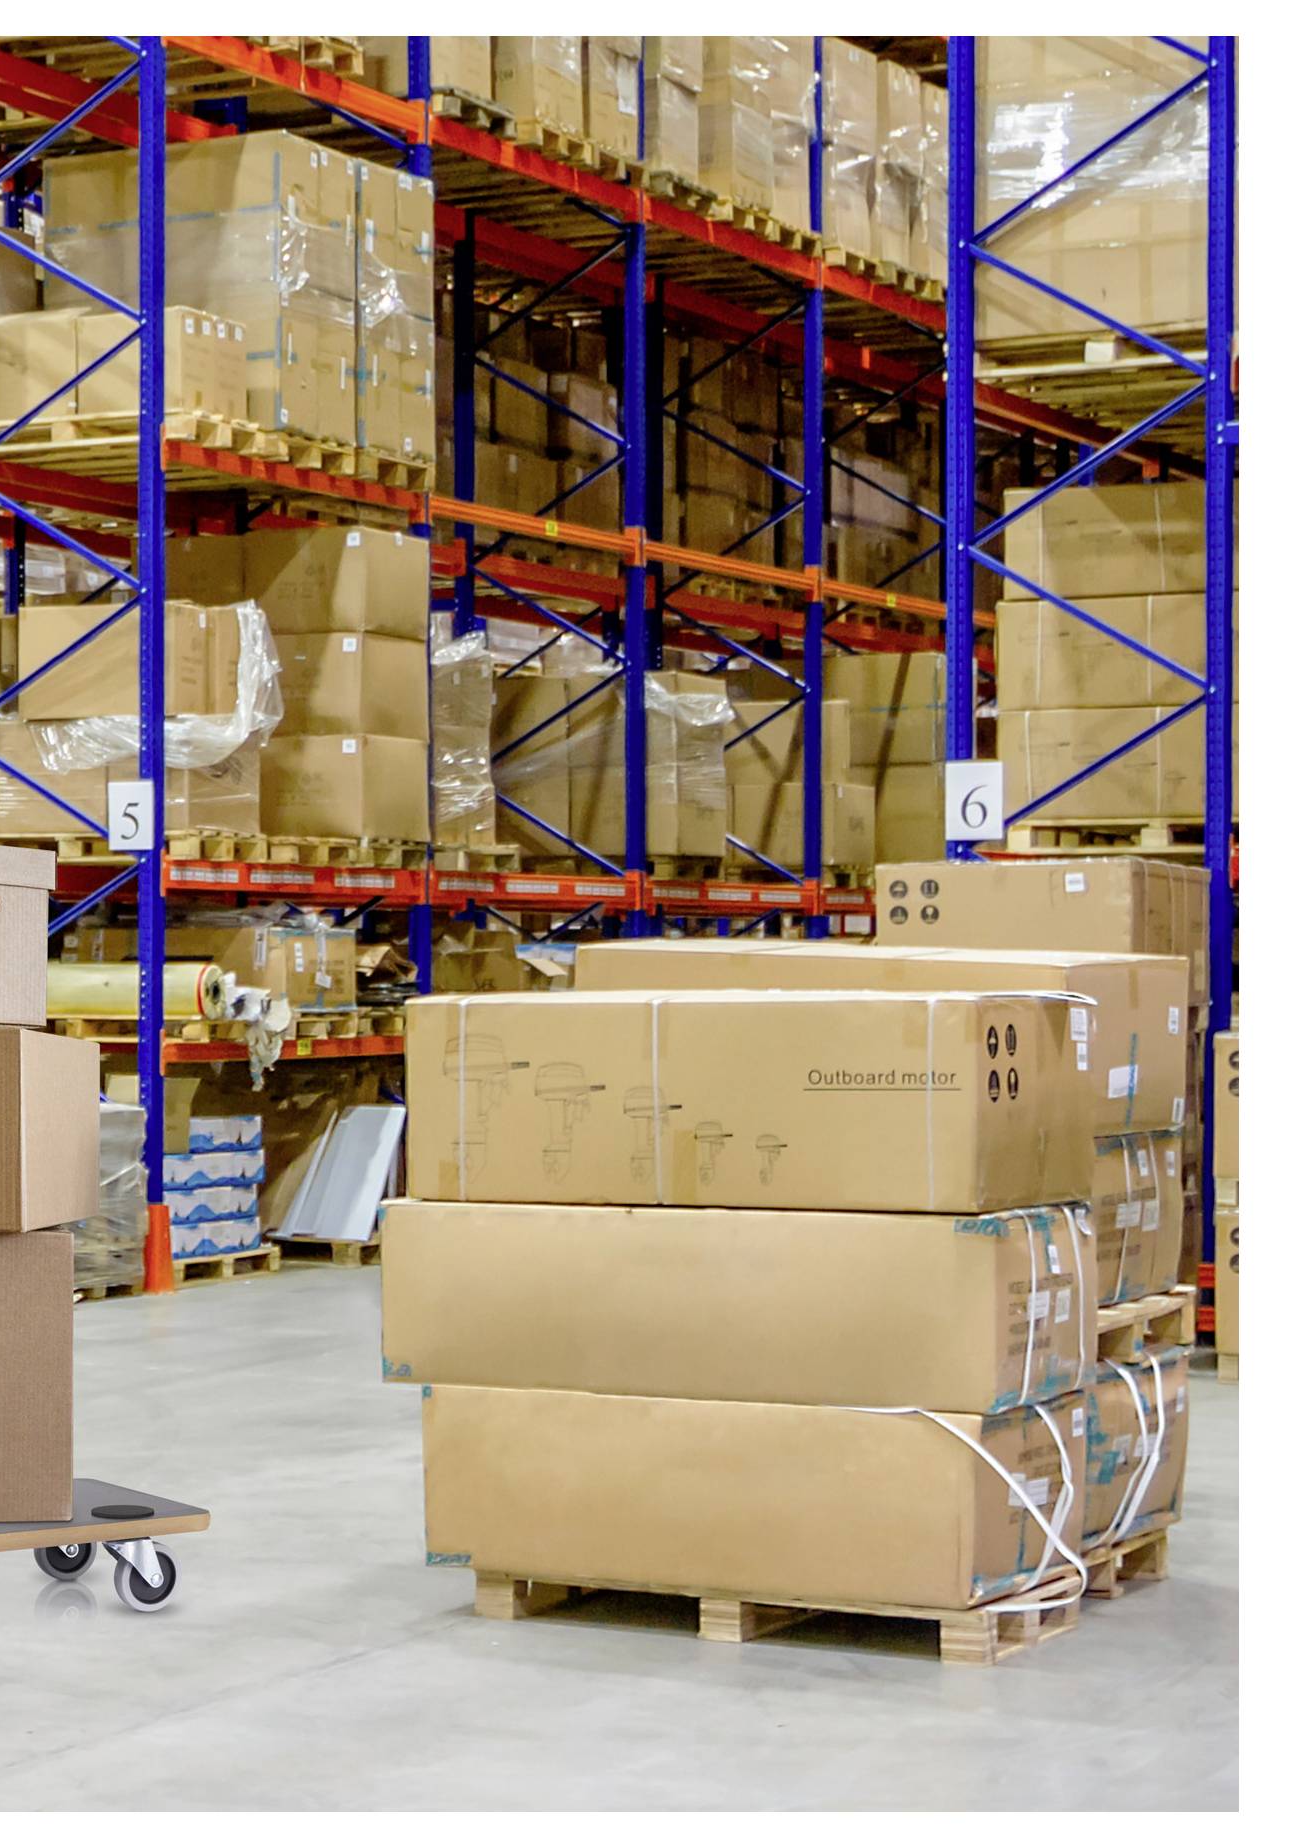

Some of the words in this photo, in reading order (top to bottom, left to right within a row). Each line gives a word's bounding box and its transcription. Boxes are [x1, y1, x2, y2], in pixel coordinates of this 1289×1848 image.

[121, 802, 140, 840] 5
[961, 785, 989, 829] 6
[807, 1069, 896, 1086] Outboard
[901, 1069, 957, 1086] motor
